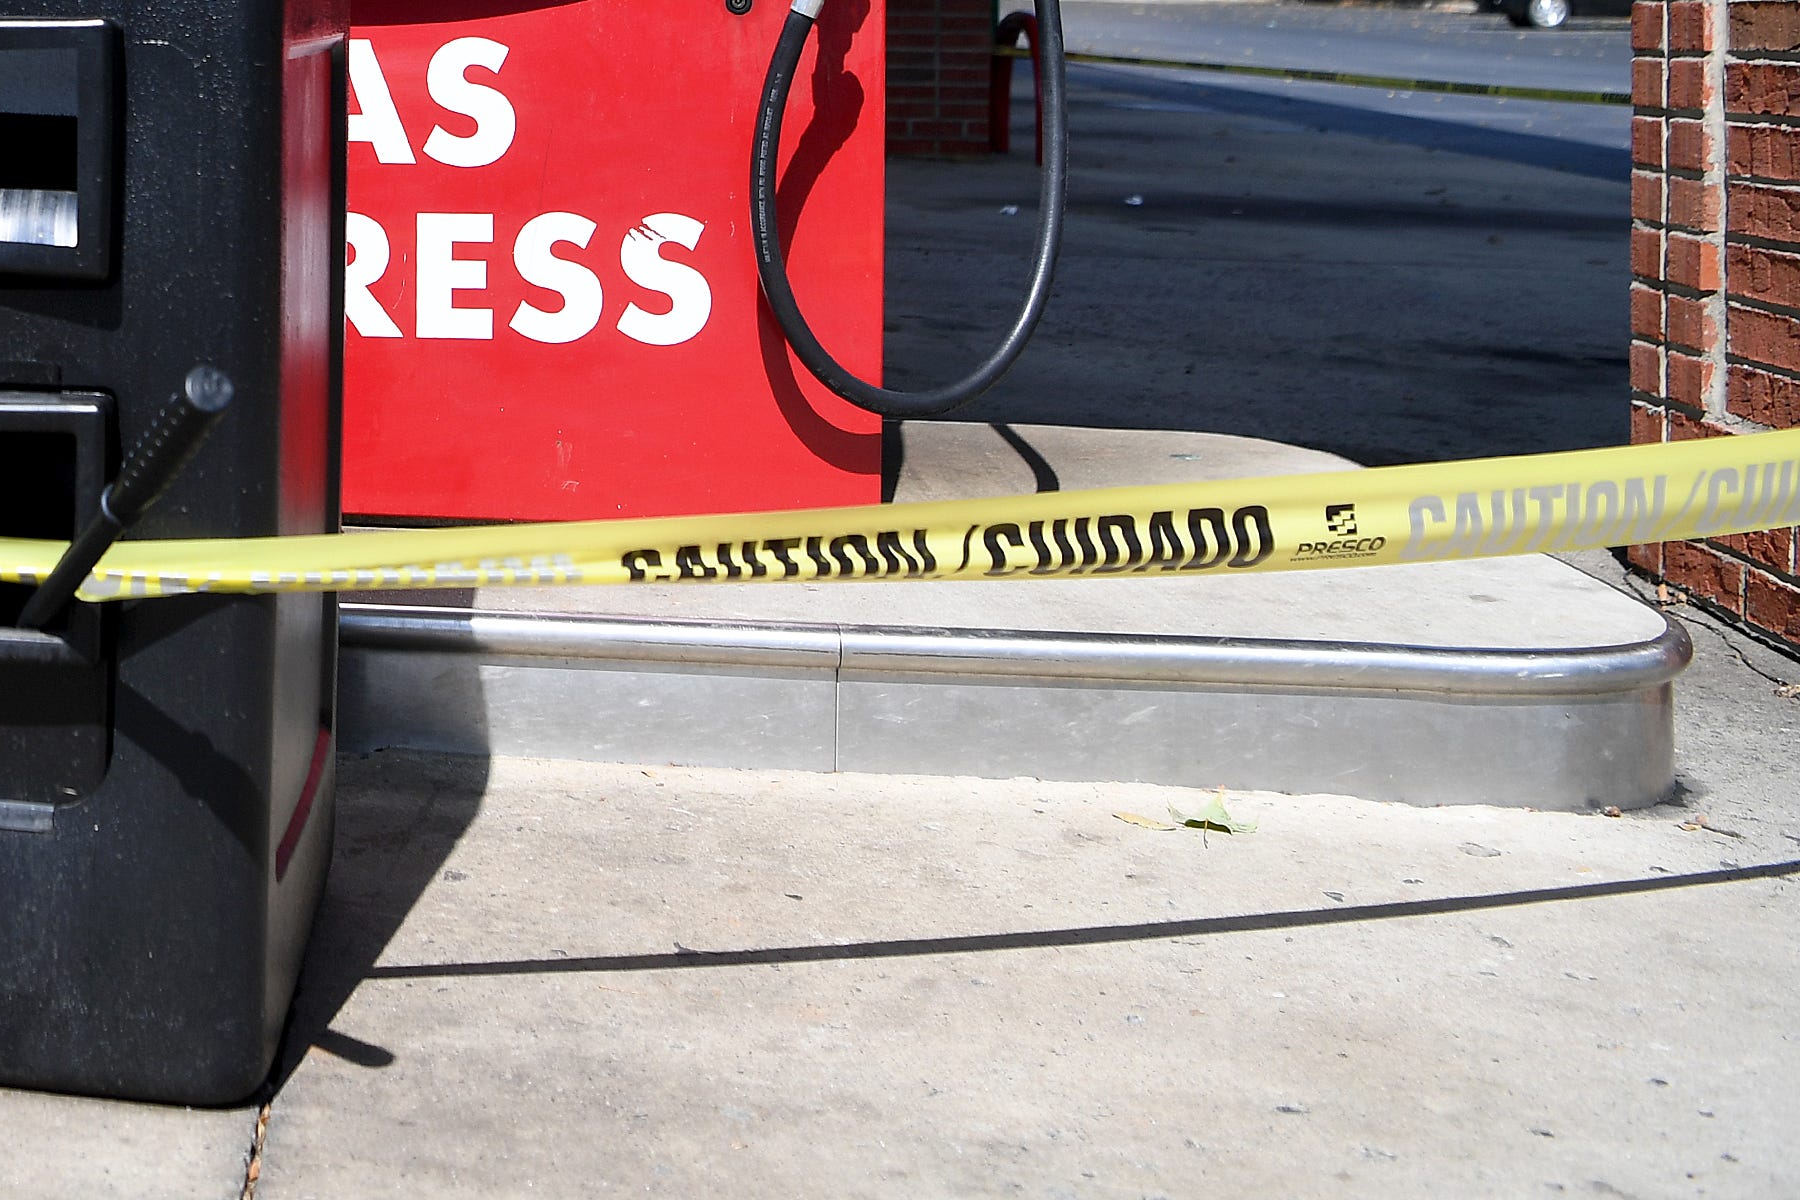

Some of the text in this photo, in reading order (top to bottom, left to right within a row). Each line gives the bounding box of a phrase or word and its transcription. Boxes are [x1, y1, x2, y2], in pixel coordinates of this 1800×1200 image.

[347, 36, 517, 168] AS
[345, 210, 712, 346] RESS
[1295, 537, 1387, 556] PRESCO
